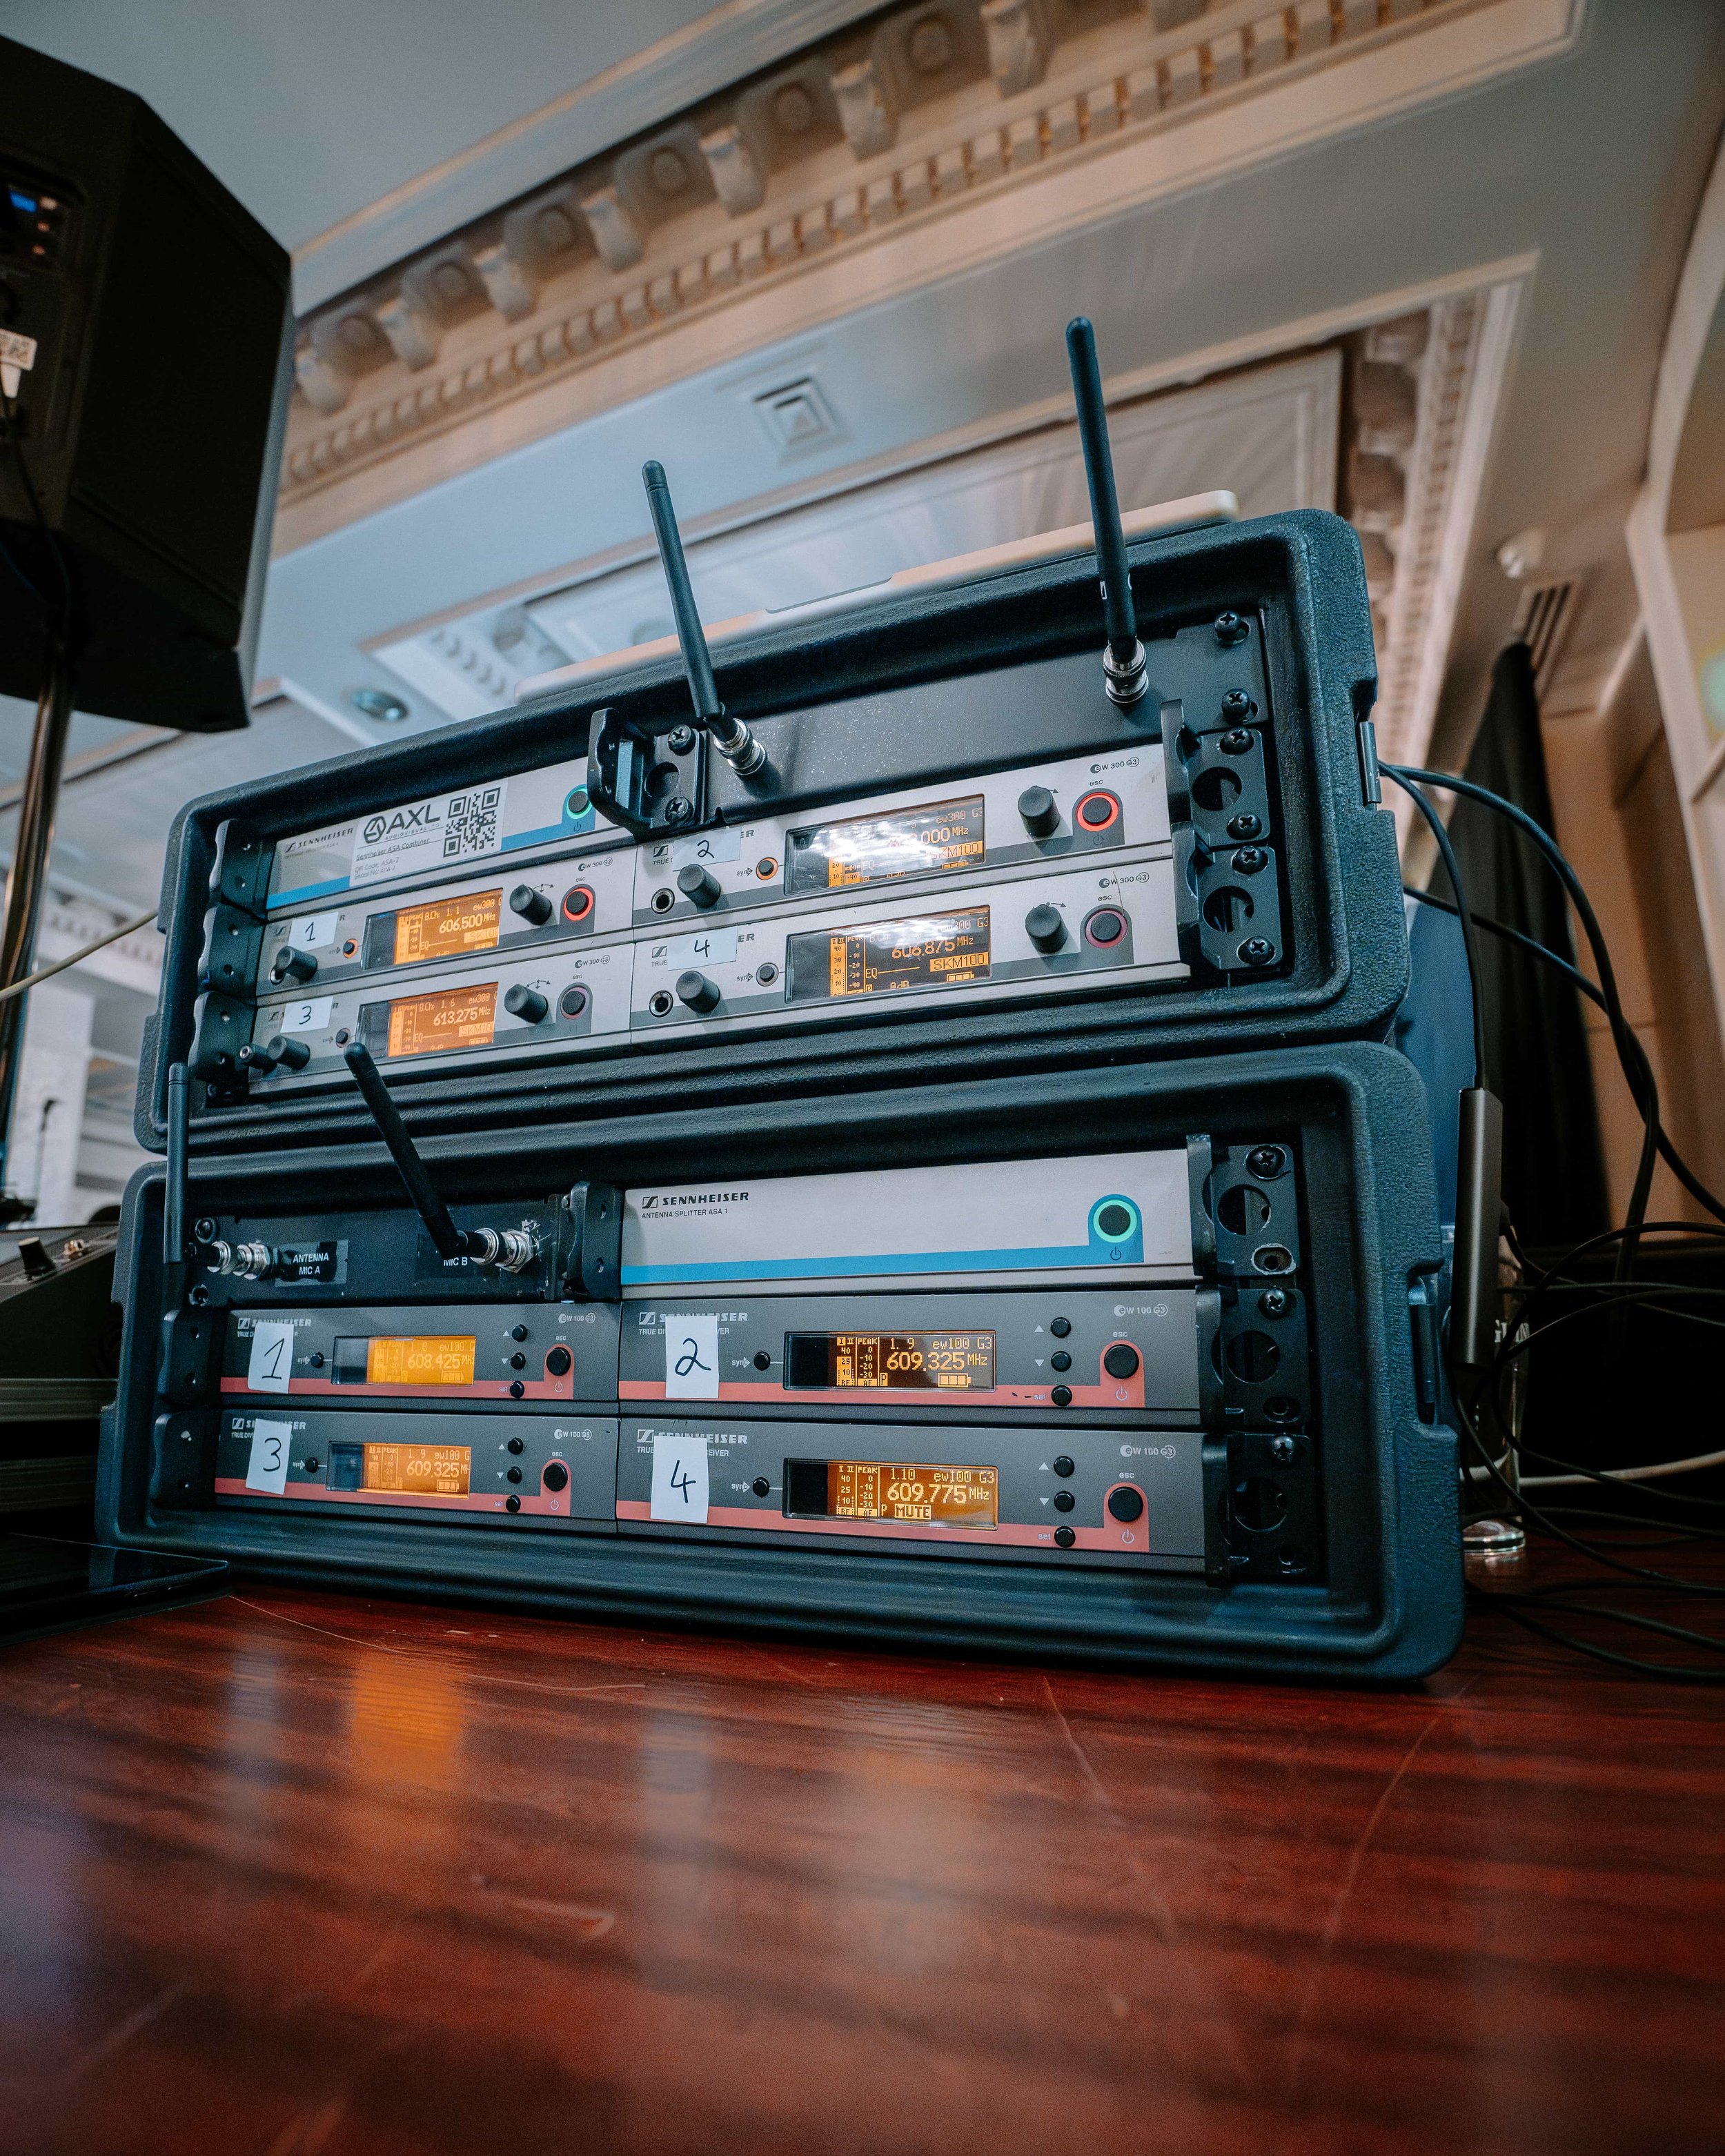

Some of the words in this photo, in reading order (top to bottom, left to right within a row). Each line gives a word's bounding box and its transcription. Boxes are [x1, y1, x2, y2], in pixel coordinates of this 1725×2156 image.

[386, 804, 440, 834] AXL
[936, 810, 966, 824] ew300
[297, 828, 353, 849] SENNHEISER
[952, 826, 969, 837] MHz
[697, 840, 714, 858] 2
[439, 913, 482, 933] 606.500
[483, 912, 496, 923] MHz
[977, 917, 989, 928] G3
[305, 922, 316, 941] 1
[421, 940, 430, 951] EQ
[694, 939, 710, 958] 4
[956, 936, 974, 947] MHz
[934, 954, 985, 971] SKM100
[866, 968, 878, 979] EQ
[299, 1006, 312, 1025] 3
[433, 1007, 478, 1027] 613.275
[478, 1006, 491, 1016] MHz
[414, 1033, 424, 1043] EQ
[662, 1192, 749, 1206] SENNHEISER
[642, 1211, 673, 1219] ANTENNA
[675, 1209, 707, 1218] SPLITTER
[293, 1252, 329, 1263] ANTENNA
[444, 1257, 459, 1267] MIC
[461, 1256, 468, 1266] B
[299, 1265, 313, 1275] MIC
[315, 1265, 320, 1275] A
[932, 1337, 969, 1349] ew100
[977, 1337, 992, 1349] G3
[262, 1338, 284, 1380] 1
[407, 1353, 461, 1370] 608.425
[675, 1338, 711, 1376] 2
[887, 1352, 965, 1372] 609.325
[967, 1354, 987, 1365] MHz
[264, 1438, 282, 1472] 3
[434, 1450, 460, 1461] ew100
[406, 1461, 460, 1478] 609.325
[891, 1467, 916, 1481] 1.10
[934, 1470, 972, 1483] ew100
[979, 1471, 994, 1484] G3
[671, 1460, 696, 1503] 4
[887, 1482, 967, 1505] 609.775
[969, 1487, 989, 1501] MHz
[881, 1503, 887, 1516] P
[896, 1504, 930, 1519] MUTE
